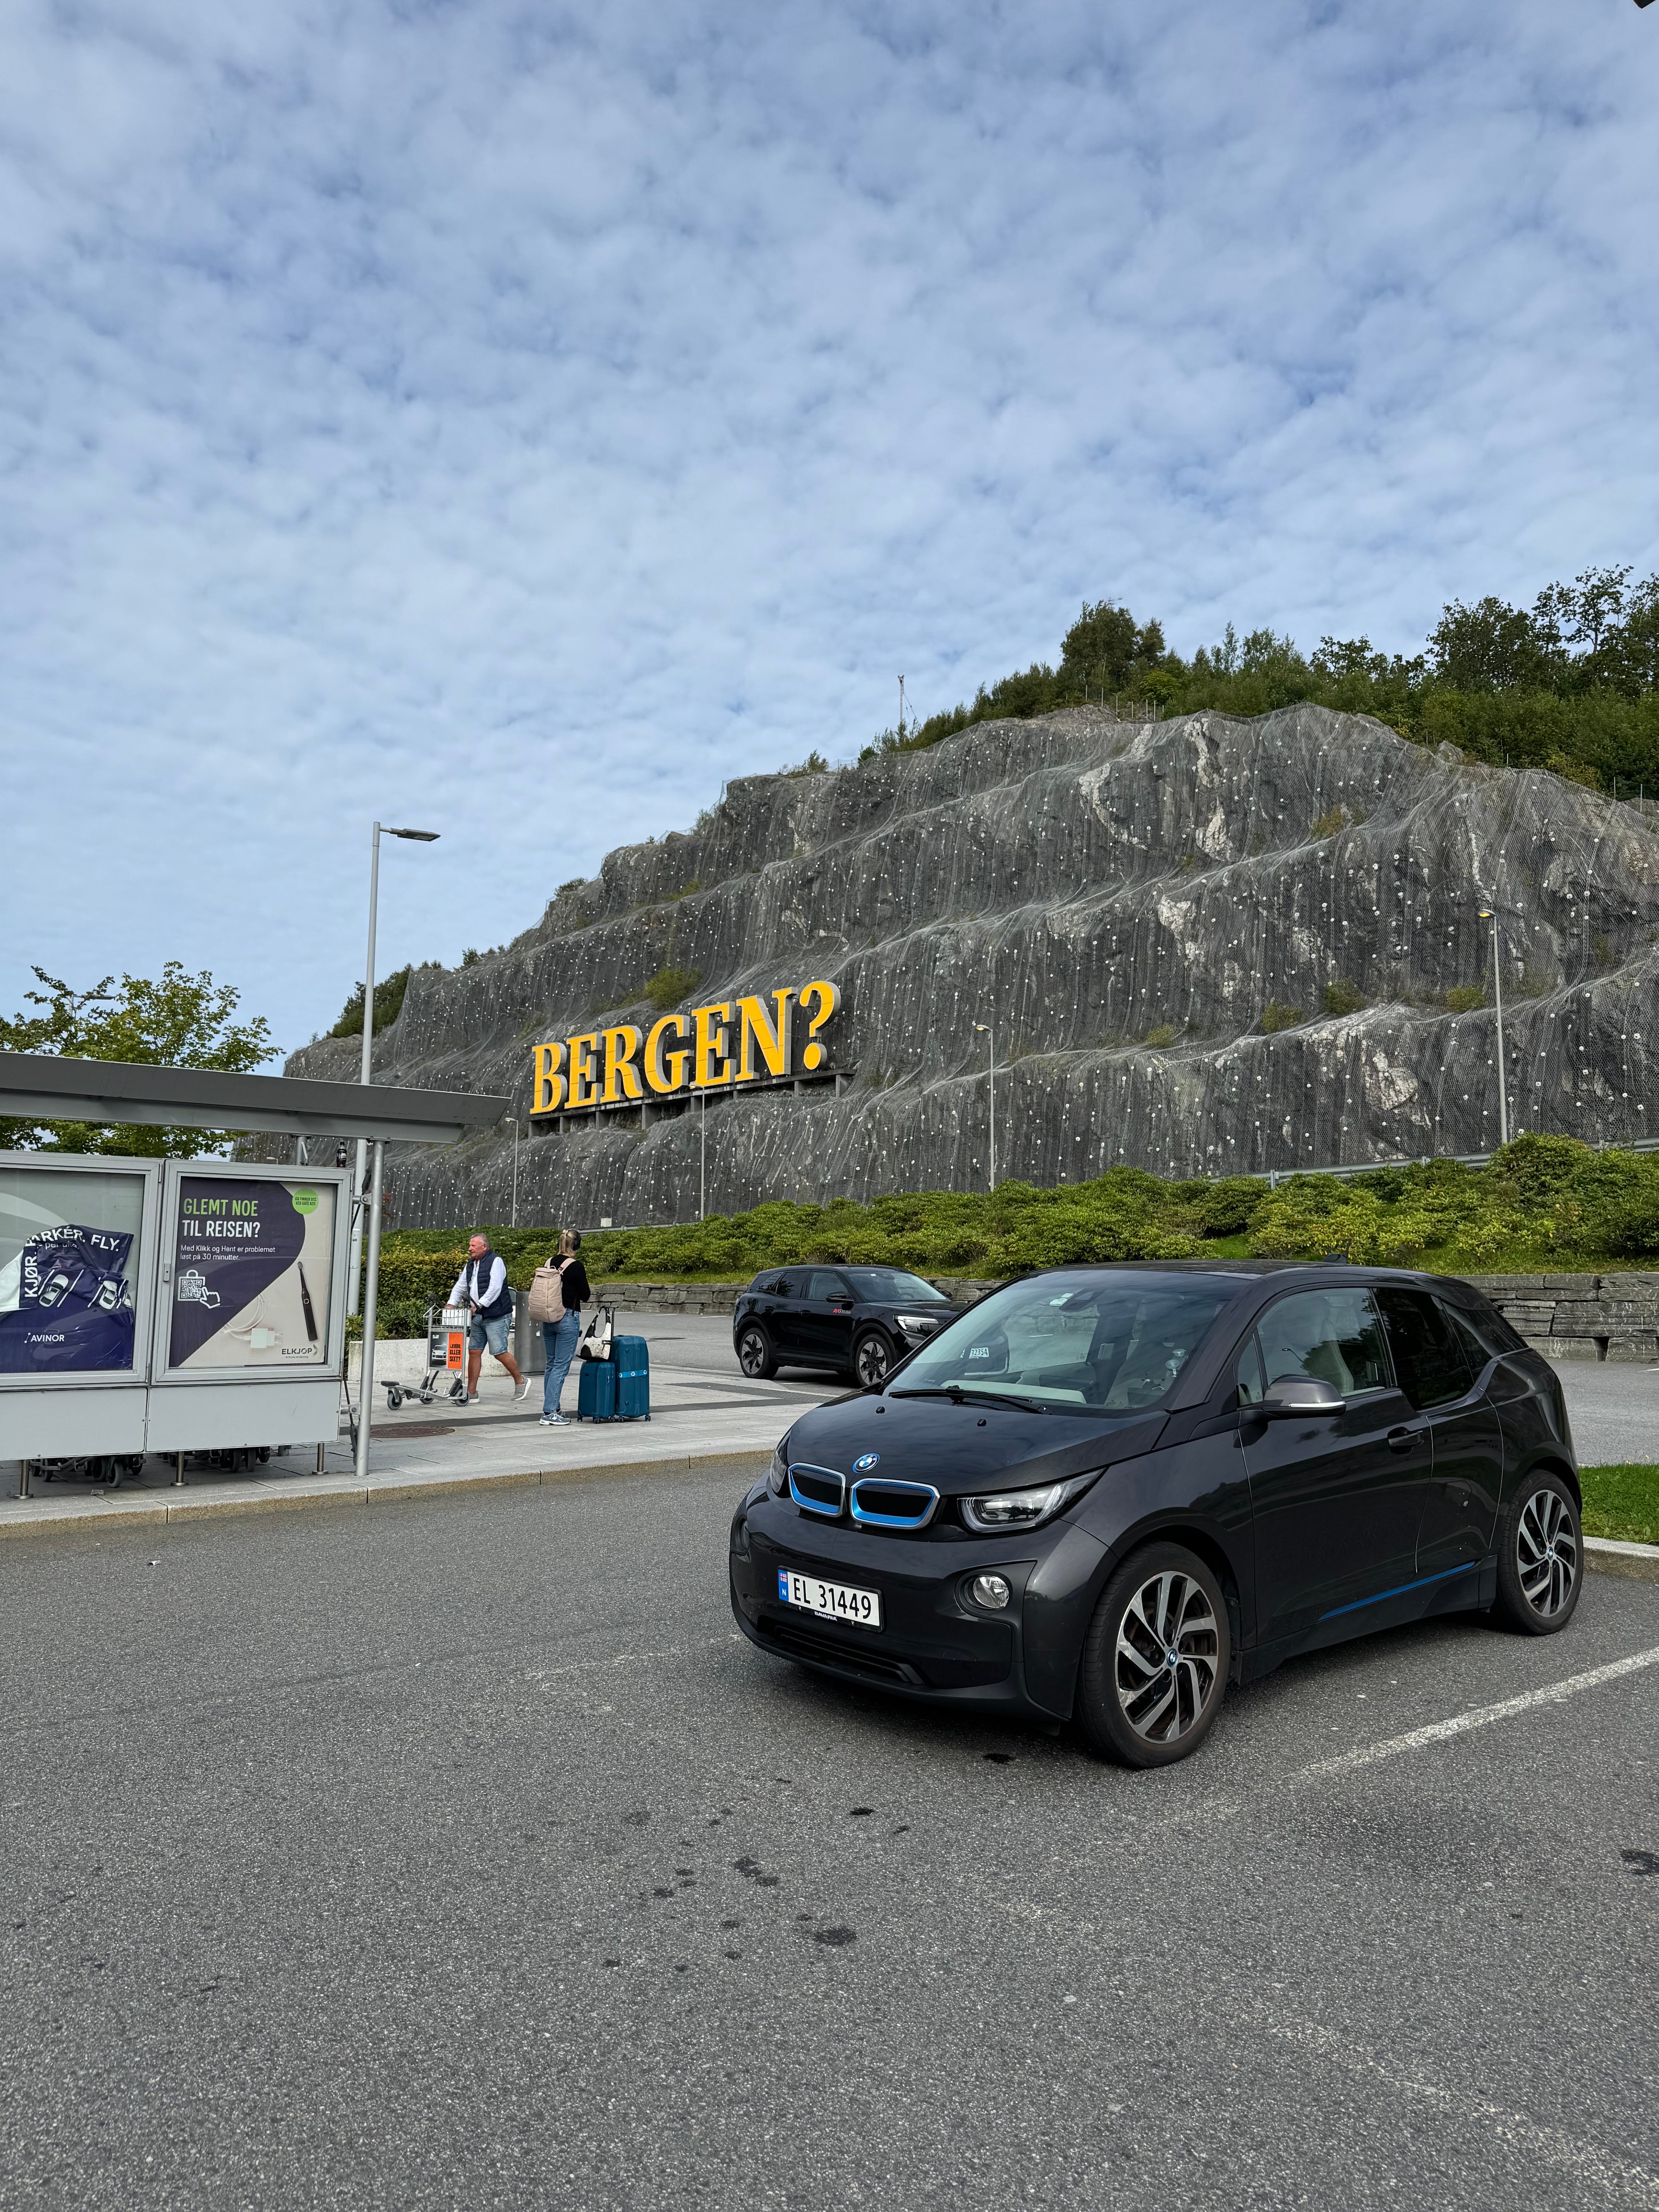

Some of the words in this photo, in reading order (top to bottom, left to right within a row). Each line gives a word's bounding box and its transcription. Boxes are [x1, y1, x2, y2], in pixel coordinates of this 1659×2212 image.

[529, 981, 841, 1115] BERGEN?
[184, 1198, 228, 1215] GLEMT
[232, 1200, 259, 1216] NOE
[182, 1220, 202, 1237] TIL
[206, 1221, 261, 1238] REISEN?
[24, 1252, 38, 1297] KJØR.
[91, 1234, 120, 1252] FLY.
[793, 1577, 811, 1604] EL
[819, 1585, 871, 1619] 31449
